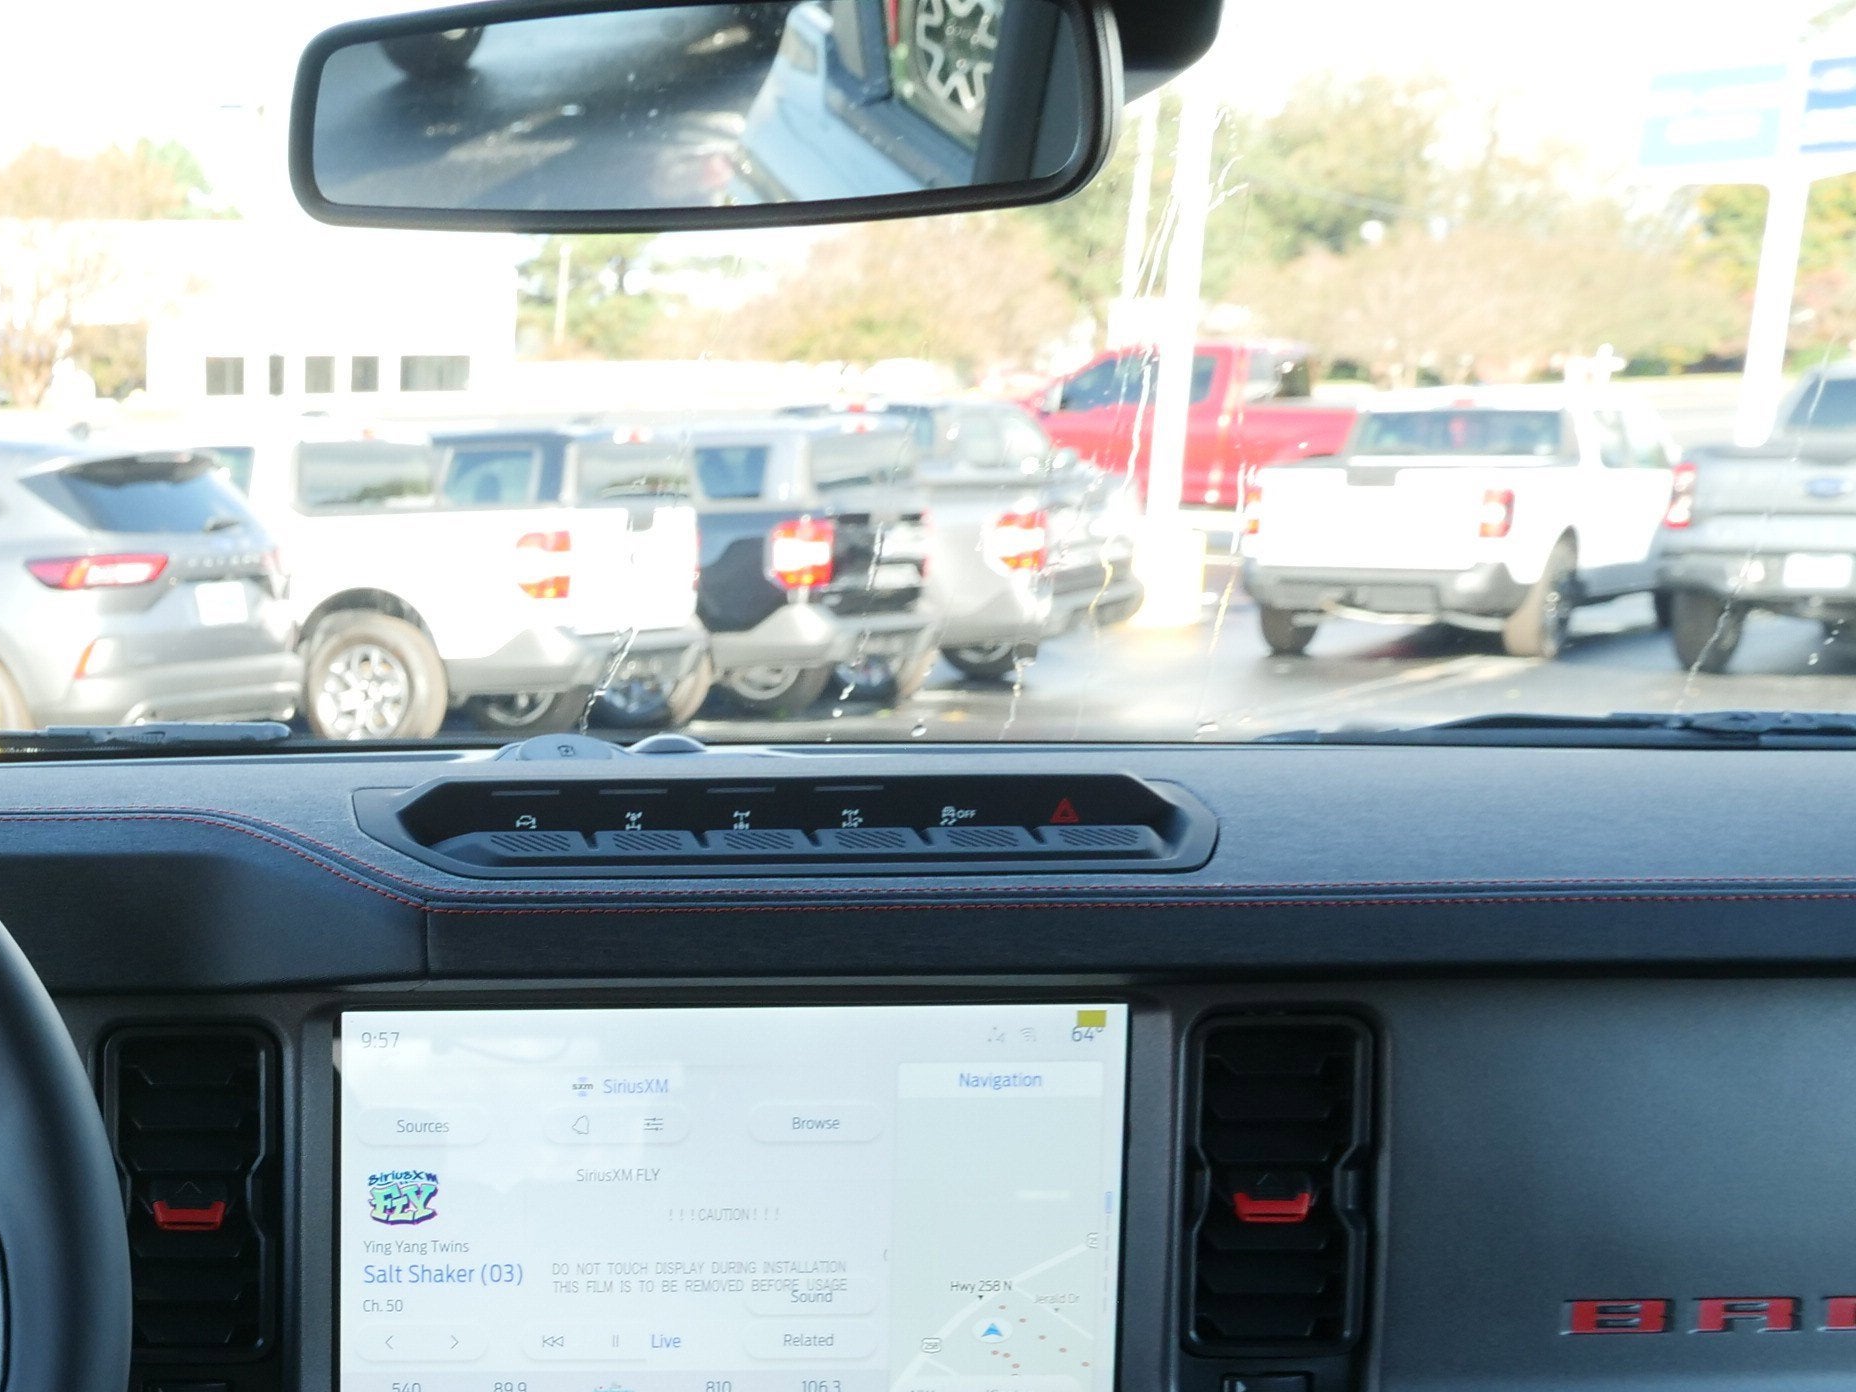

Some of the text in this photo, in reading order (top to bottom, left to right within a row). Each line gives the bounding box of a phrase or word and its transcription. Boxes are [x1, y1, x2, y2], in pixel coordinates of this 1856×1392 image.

[361, 1031, 400, 1049] 9:57
[603, 1078, 669, 1094] SiriusXM
[958, 1072, 1043, 1091] Navigation
[396, 1119, 449, 1134] Sources
[791, 1116, 840, 1130] Browse
[576, 1168, 660, 1182] SiriusXM FLY
[363, 1240, 469, 1256] Ying Yang Twins
[363, 1262, 524, 1287] Salt Shaker (03)
[552, 1260, 847, 1275] DO NOT TOUCH DISPLAY DURING INSTALLATION
[553, 1278, 848, 1293] THIS FILM IS TO BE REMOVED BEFORE USAGE
[950, 1280, 1013, 1293] Hwy 258 N
[790, 1290, 833, 1303] Sound
[363, 1299, 404, 1313] Ch. 50
[651, 1334, 682, 1348] Live
[783, 1333, 834, 1347] Related
